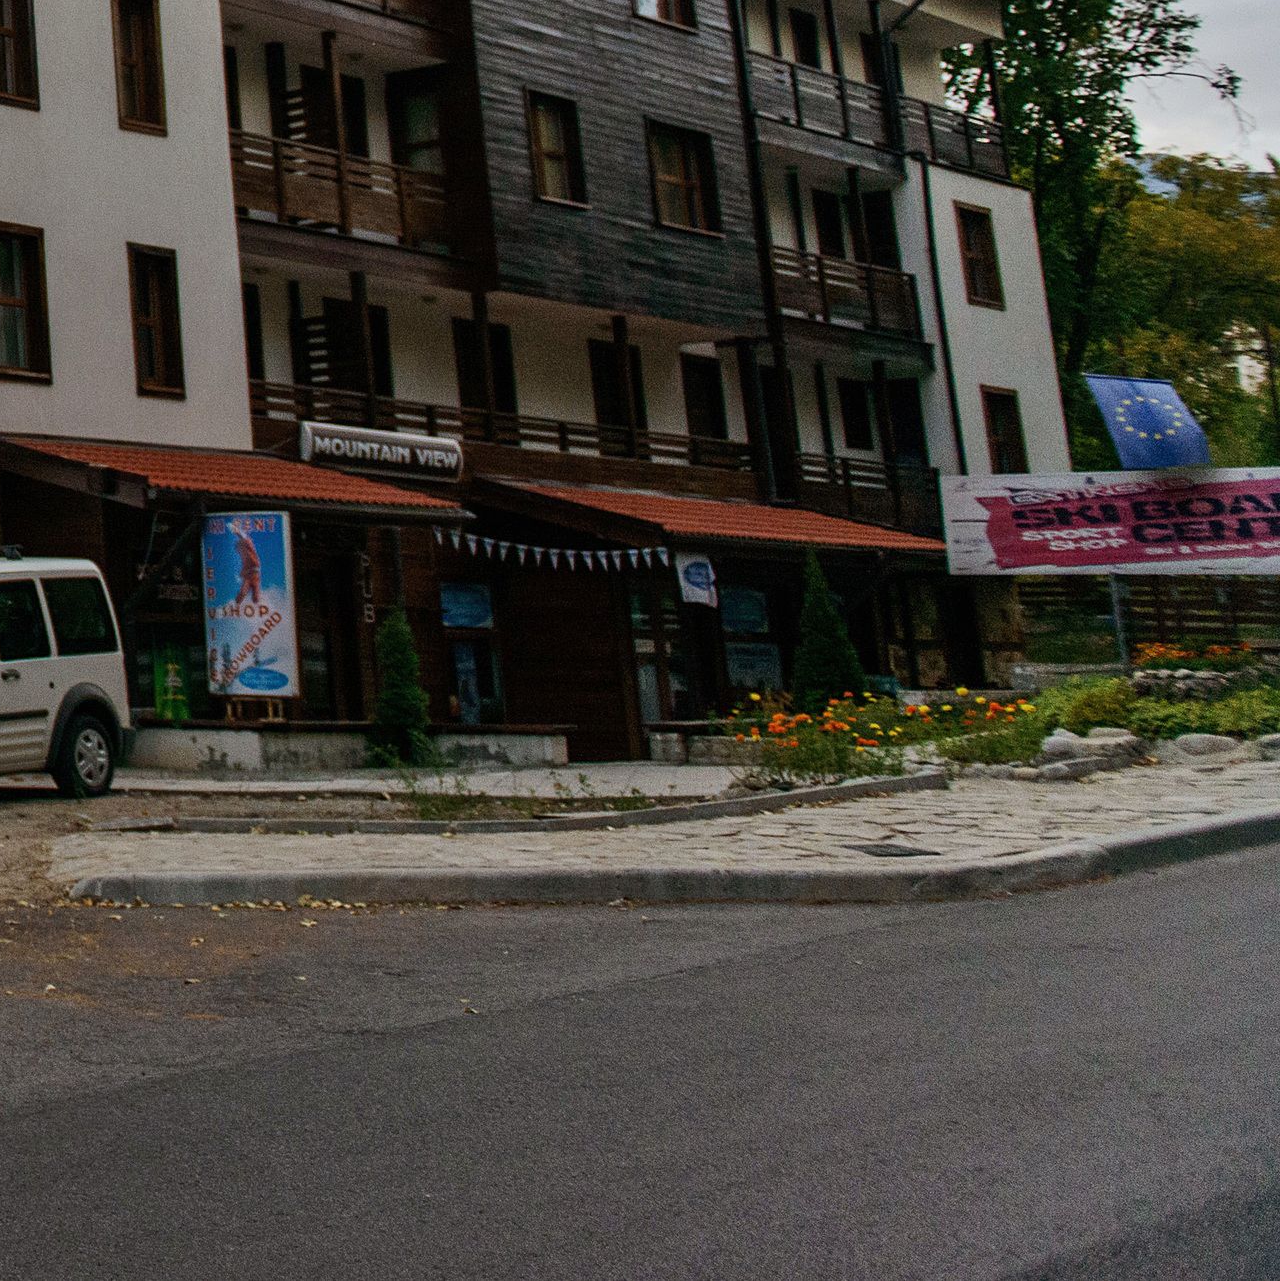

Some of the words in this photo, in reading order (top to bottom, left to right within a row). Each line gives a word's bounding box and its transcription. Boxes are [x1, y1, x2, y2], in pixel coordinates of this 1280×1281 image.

[313, 435, 411, 464] MOUNTAIN
[414, 447, 459, 469] VIEW
[1011, 503, 1120, 529] SKI
[1022, 526, 1122, 542] SPORT
[1049, 537, 1128, 552] SHOP
